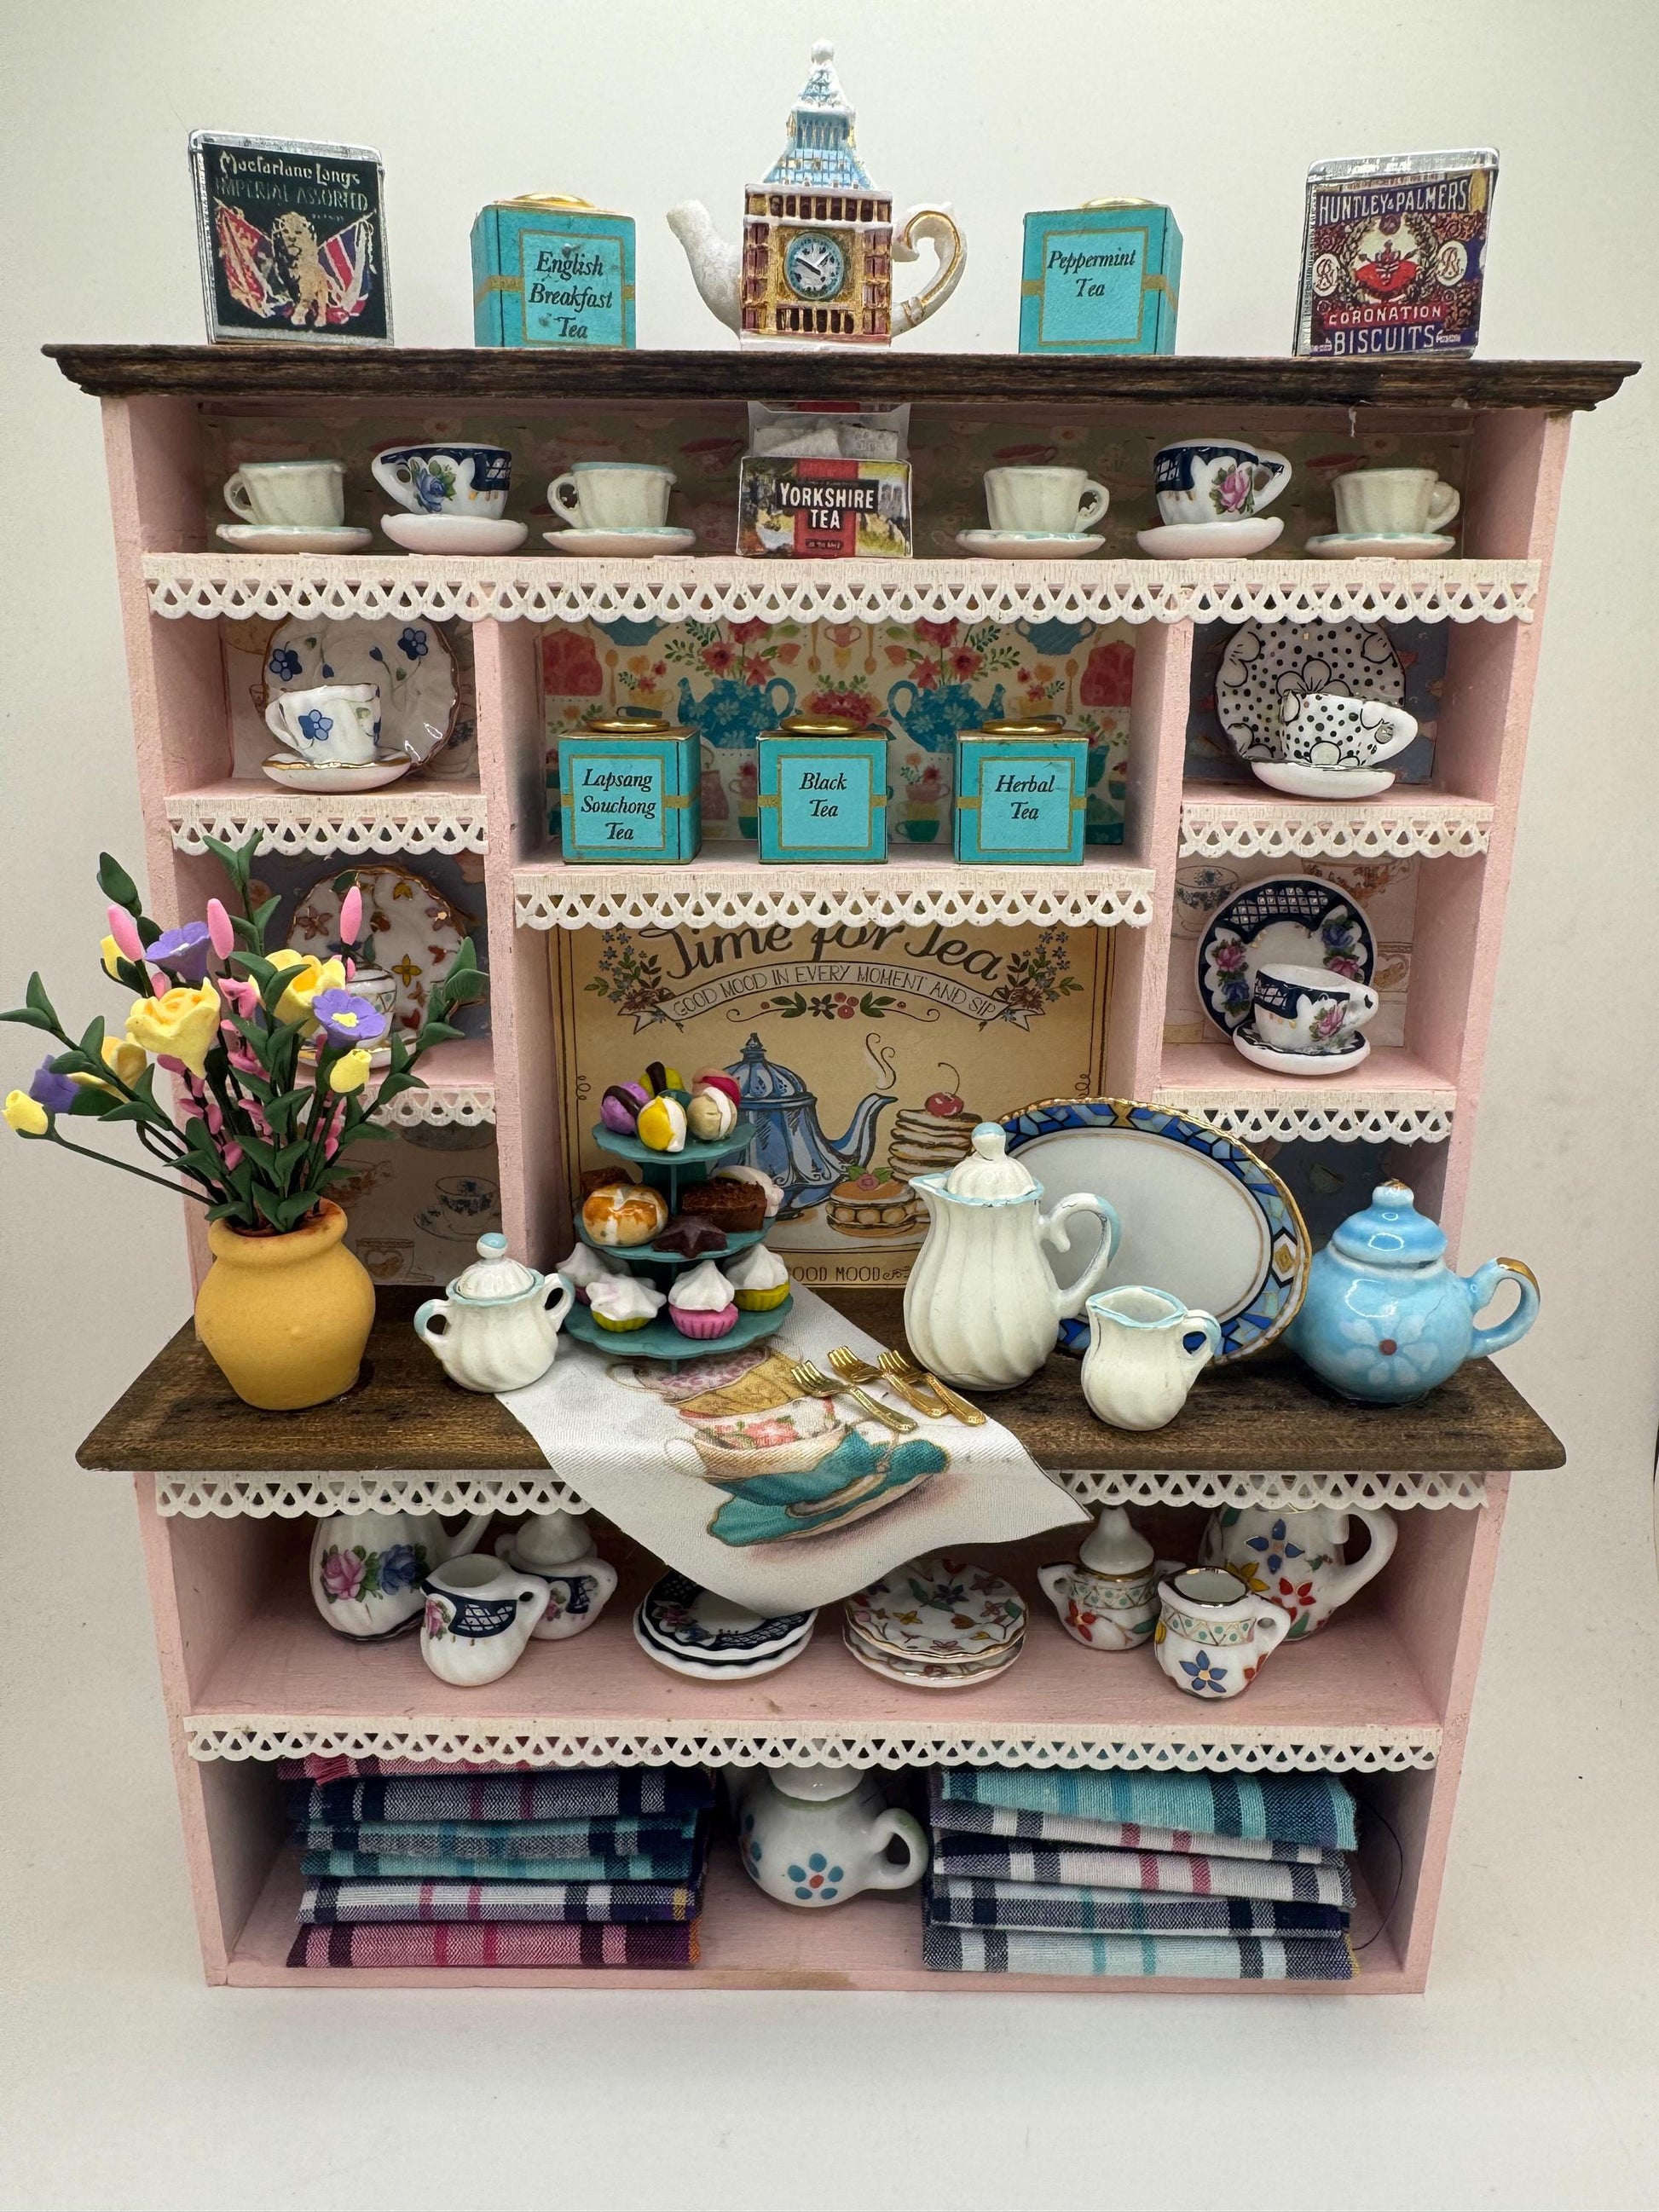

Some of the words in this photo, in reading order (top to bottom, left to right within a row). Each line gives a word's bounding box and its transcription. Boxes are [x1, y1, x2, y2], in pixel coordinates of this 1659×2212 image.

[215, 176, 289, 202] IMPERIAL
[298, 187, 368, 211] ASSORTED
[1318, 193, 1389, 227] HUNTLEY
[1396, 179, 1469, 212] PALMERS
[535, 251, 604, 281] English
[1047, 247, 1136, 274] Peppermint
[528, 282, 614, 313] Breakfast
[1076, 277, 1106, 297] Tea
[552, 316, 588, 338] Tea
[1328, 305, 1442, 325] CORONATION
[1333, 325, 1436, 355] BISCUITS
[779, 482, 875, 509] YORKSHIRE
[810, 509, 841, 529] TEA
[581, 768, 653, 793] Lapsang
[799, 772, 847, 790] Black
[995, 775, 1055, 794] Herbal
[581, 795, 656, 819] Souchong
[810, 800, 839, 817] Tea
[1011, 801, 1039, 821] Tea
[604, 822, 634, 840] Tea
[638, 925, 794, 979] Time
[673, 988, 718, 1016] GOOD
[718, 973, 768, 997] MOOD
[772, 968, 789, 985] IN
[795, 964, 850, 982] EVERY
[858, 966, 928, 990] MOMENT
[929, 981, 968, 1005] AND
[968, 996, 996, 1016] SIP
[789, 1266, 828, 1282] OOD
[835, 1266, 881, 1282] MOOD
